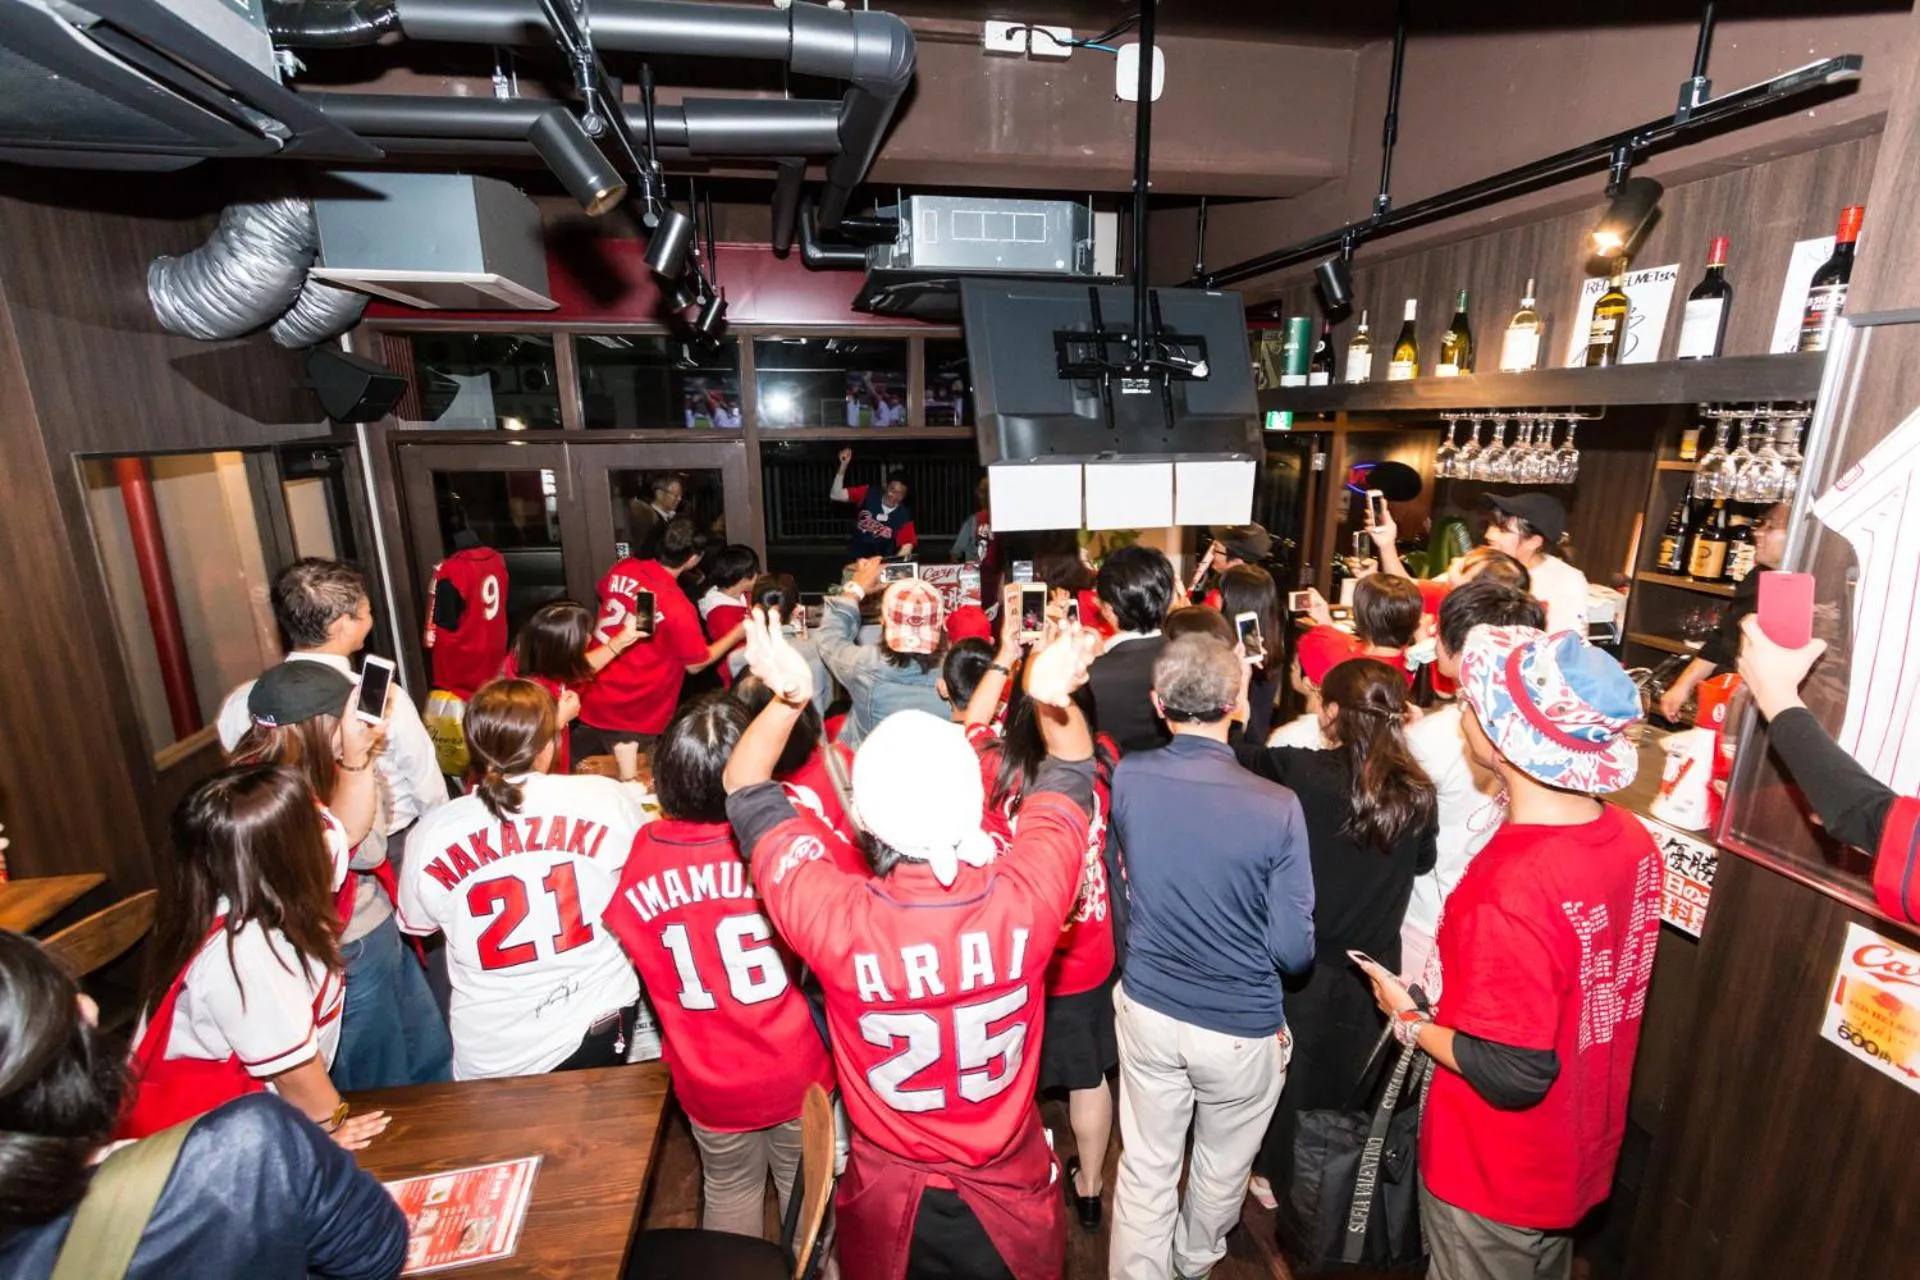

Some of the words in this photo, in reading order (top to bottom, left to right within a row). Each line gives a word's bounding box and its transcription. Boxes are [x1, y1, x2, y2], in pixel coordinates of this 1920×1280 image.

[482, 574, 499, 621] 9
[595, 599, 626, 645] 2
[423, 816, 609, 892] NAKAZAKI
[466, 861, 594, 970] 21
[660, 913, 789, 1011] 16
[854, 928, 1029, 1003] ARAI
[1852, 944, 1920, 978] Ca
[858, 984, 1028, 1114] 25
